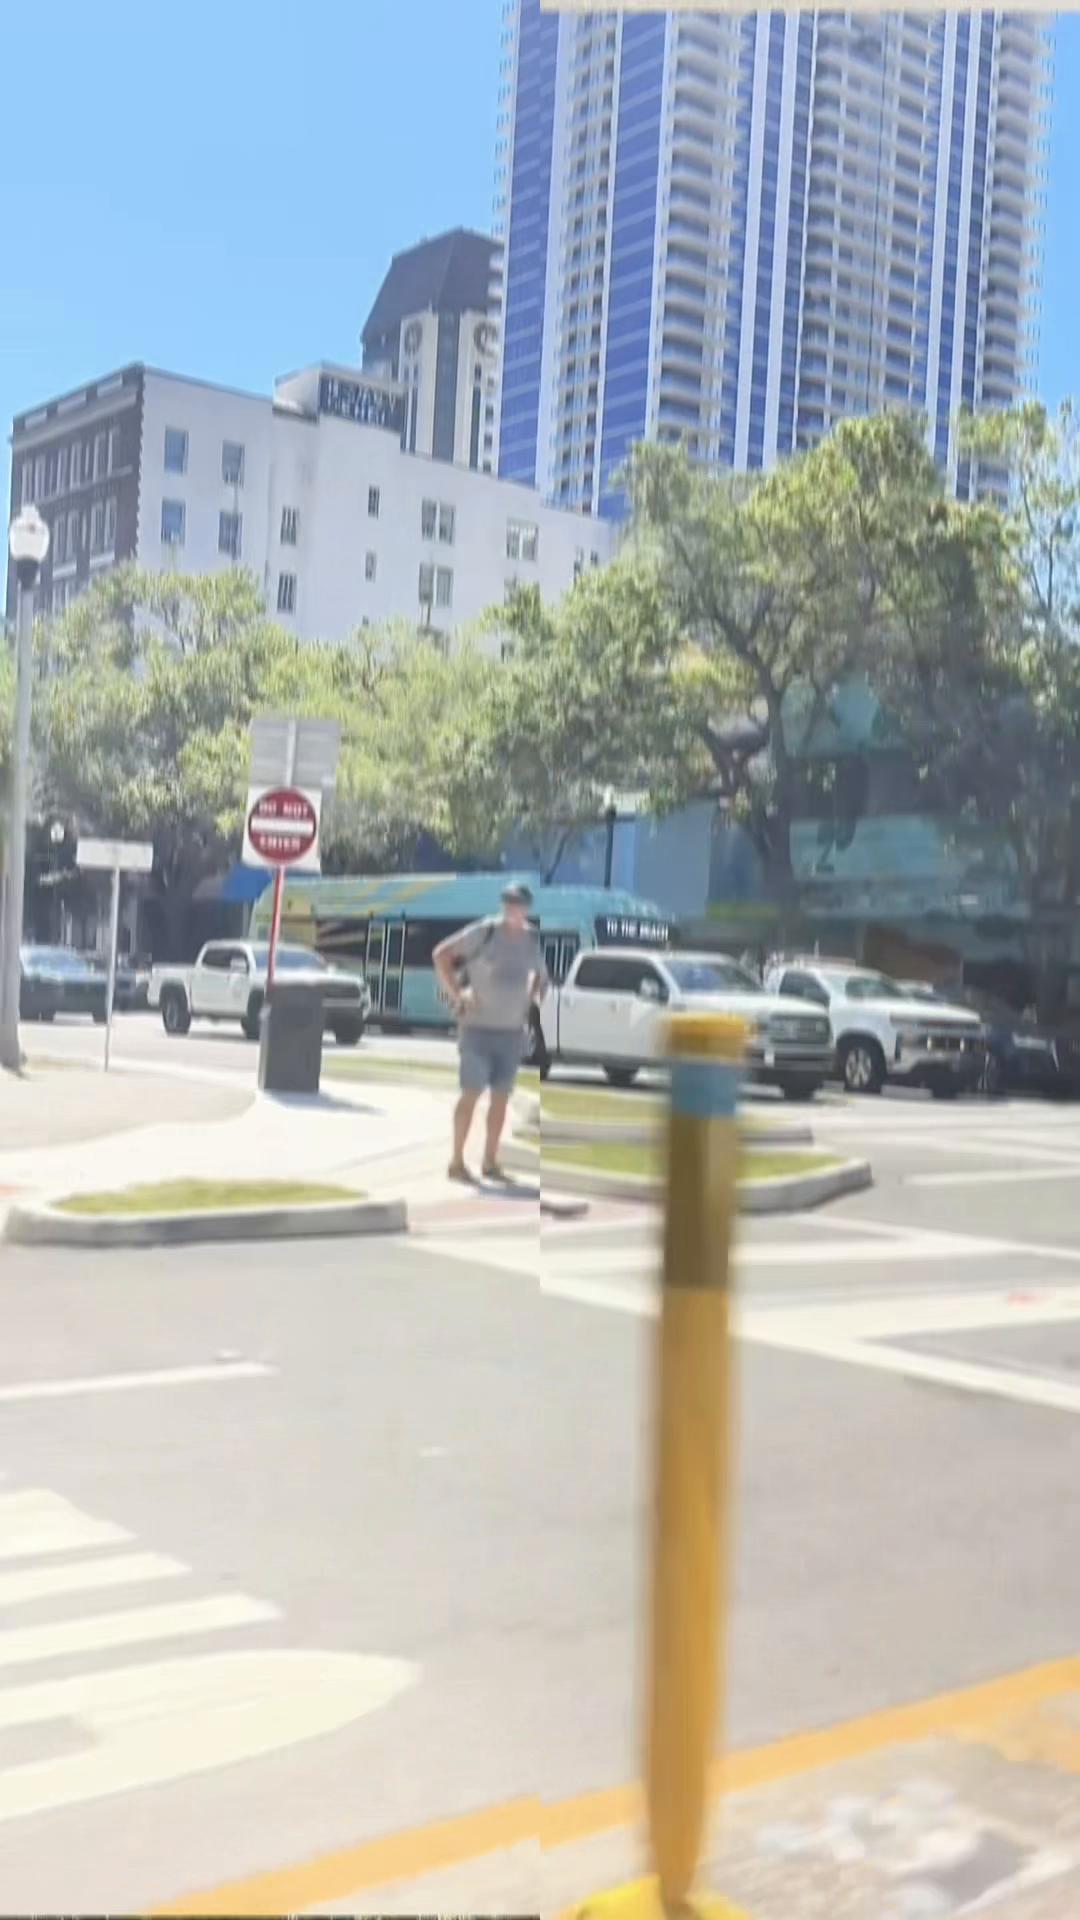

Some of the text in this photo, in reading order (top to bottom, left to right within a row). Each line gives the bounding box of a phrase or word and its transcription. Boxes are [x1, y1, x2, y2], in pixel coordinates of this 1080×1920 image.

[259, 800, 308, 817] DO NOT
[260, 835, 301, 851] ENTER
